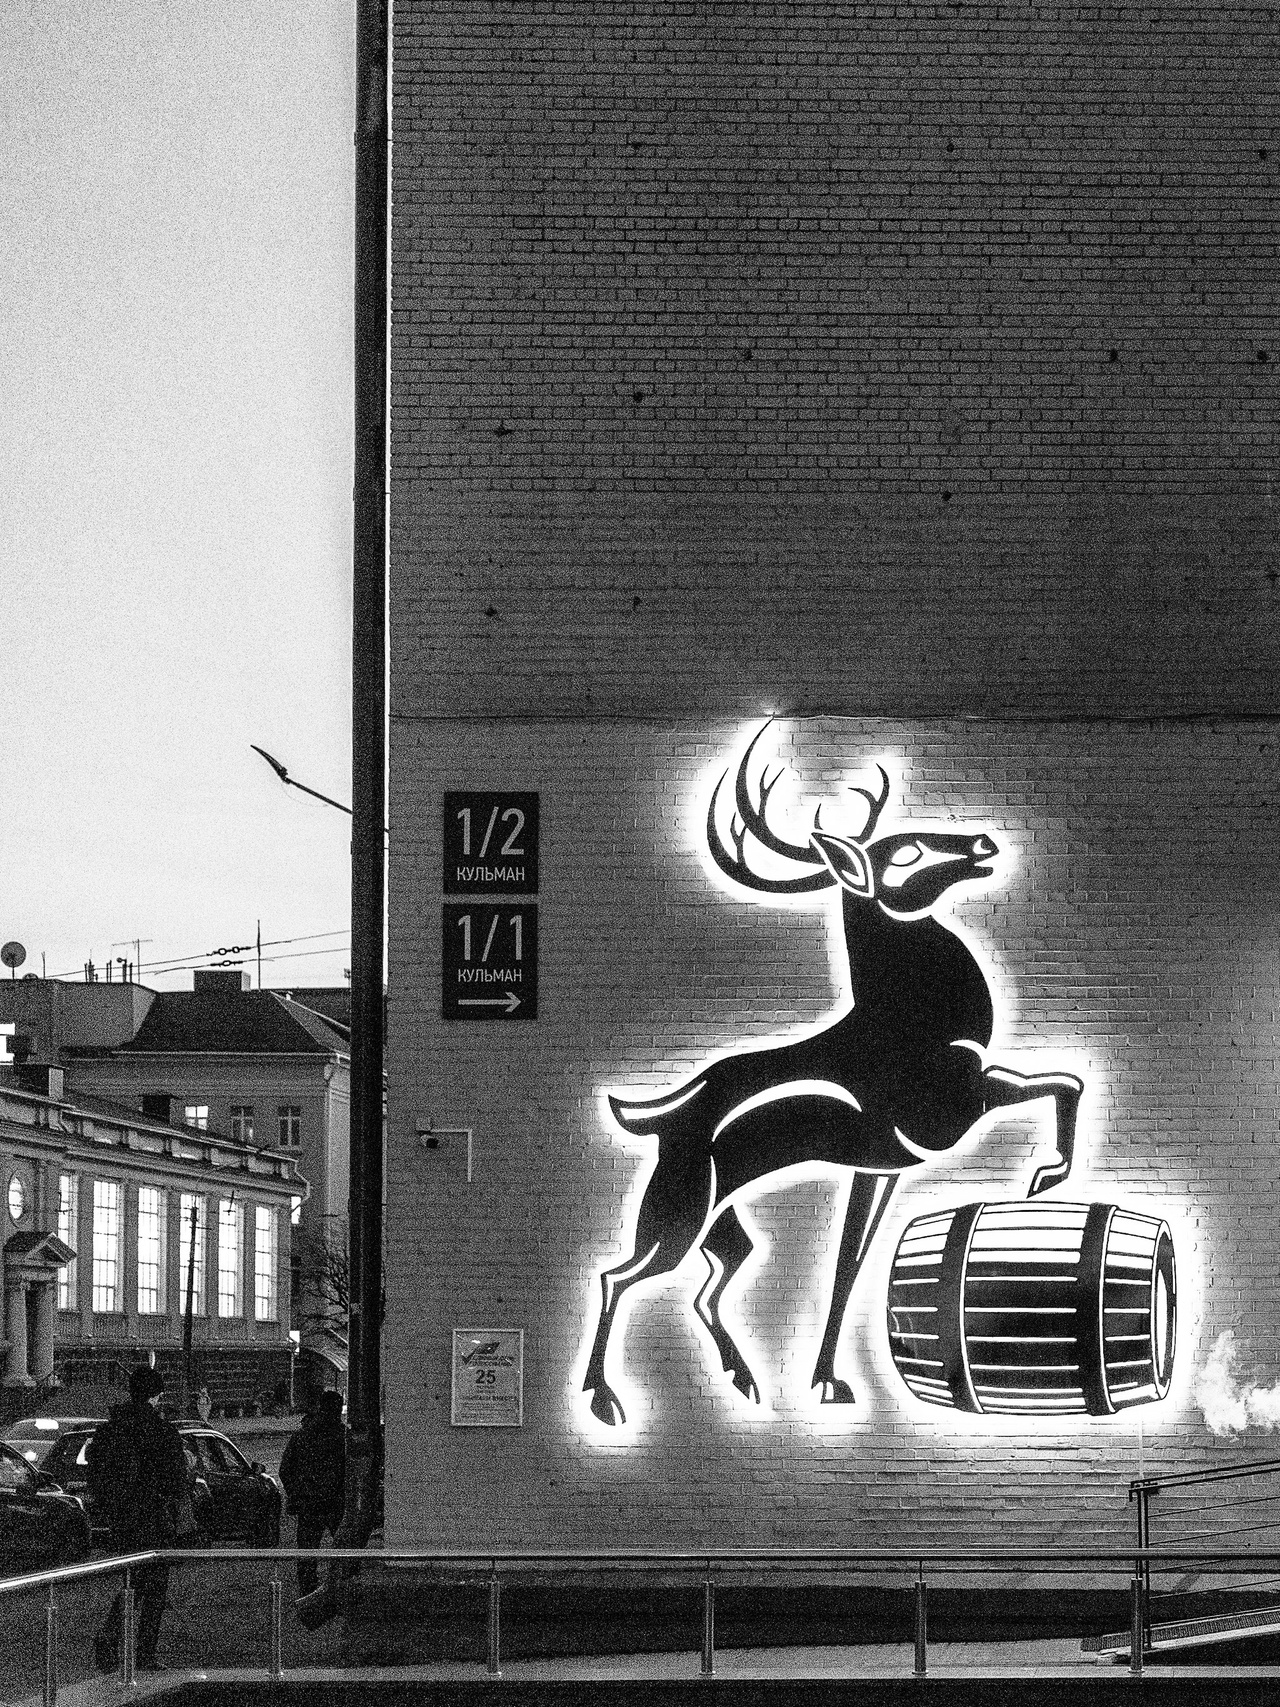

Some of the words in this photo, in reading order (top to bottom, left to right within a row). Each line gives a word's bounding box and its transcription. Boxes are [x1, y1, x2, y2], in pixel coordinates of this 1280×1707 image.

[457, 806, 526, 858] 1/2
[456, 866, 525, 881] КУЛЬМАН
[457, 914, 523, 962] 1/1
[457, 968, 522, 983] КУЛЬМАН
[475, 1369, 497, 1385] 25
